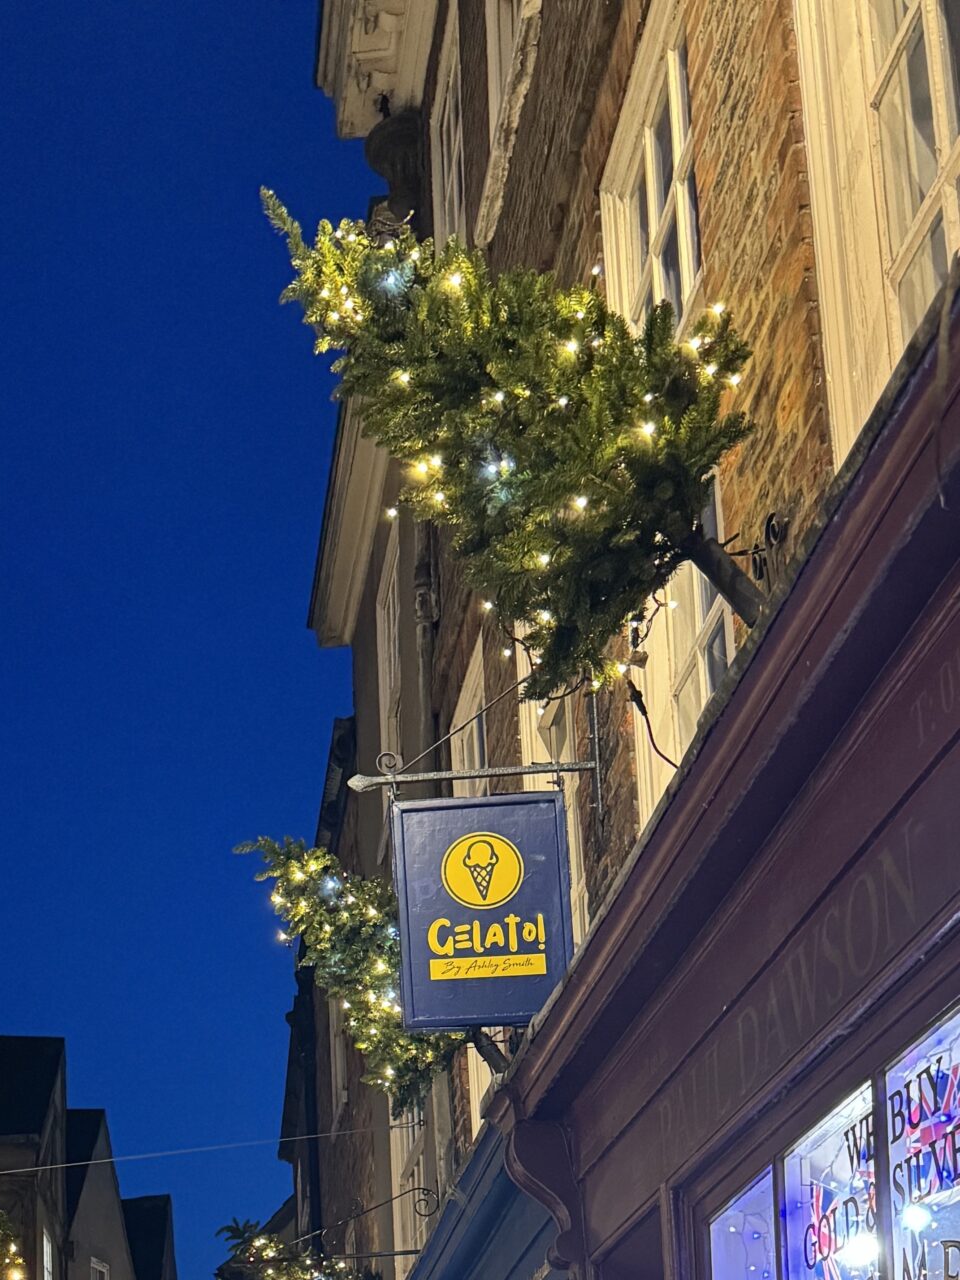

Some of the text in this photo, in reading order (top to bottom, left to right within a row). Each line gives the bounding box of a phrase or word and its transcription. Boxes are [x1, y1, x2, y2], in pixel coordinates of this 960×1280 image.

[441, 957, 535, 976] By Ashley Smith
[736, 816, 925, 1097] DAWSON
[888, 1056, 944, 1145] BUY
[803, 1195, 860, 1271] GOLD
